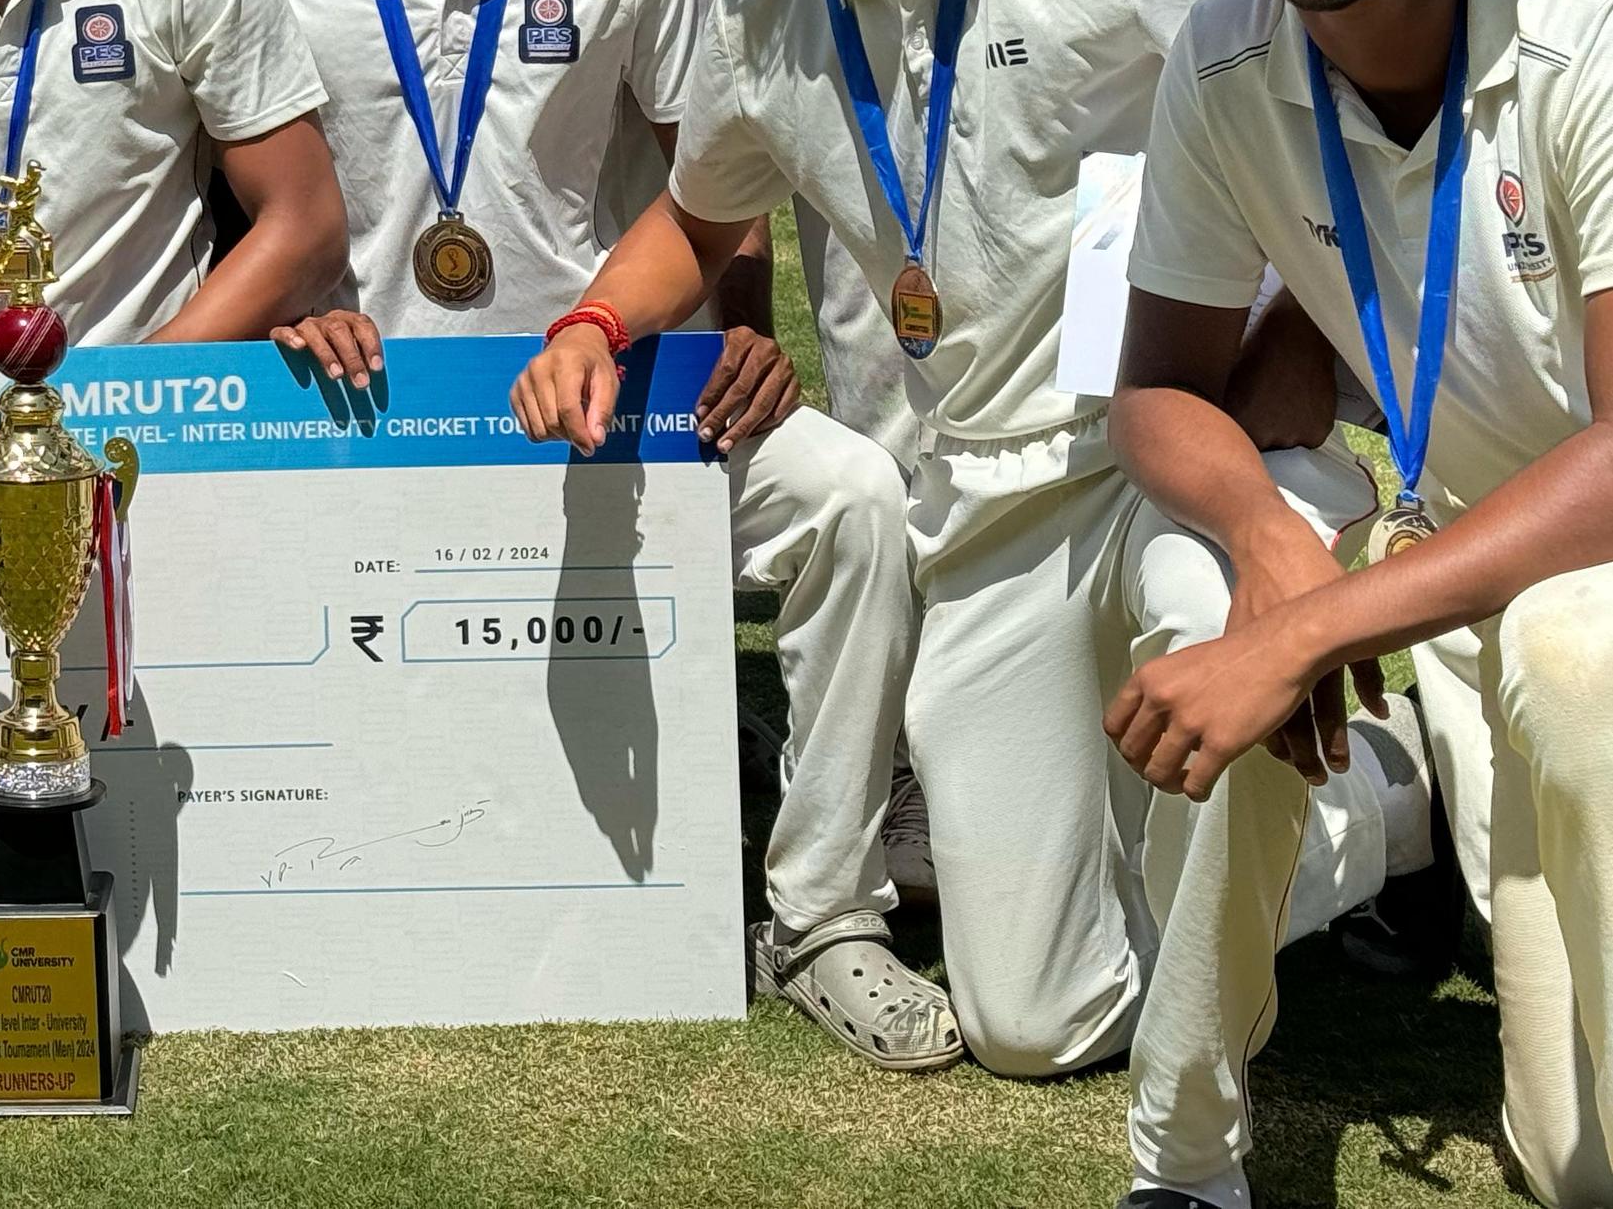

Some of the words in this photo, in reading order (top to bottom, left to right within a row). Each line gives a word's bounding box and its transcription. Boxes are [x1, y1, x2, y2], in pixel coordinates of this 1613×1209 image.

[526, 27, 573, 44] PES
[79, 44, 126, 62] PES
[1302, 215, 1341, 249] TYK
[1501, 232, 1546, 258] PS
[62, 375, 247, 417] MRUT20
[182, 422, 245, 443] INTER
[251, 418, 382, 441] UNIVERSITY
[386, 416, 480, 437] CRICKET
[434, 548, 454, 562] 16
[472, 547, 492, 561] 02
[510, 547, 550, 560] 2024
[354, 560, 401, 573] DATE:
[455, 615, 644, 651] 15,000/-
[177, 790, 235, 804] PAYER'S
[240, 789, 329, 803] SIGNATURE:
[10, 947, 35, 957] CMR
[11, 957, 75, 968] UNIVERSITY
[11, 985, 52, 1004] CMRUT20
[1, 1013, 20, 1032] level
[46, 1012, 87, 1035] University
[3, 1040, 51, 1059] Tournament
[52, 1042, 75, 1062] (Men)
[76, 1041, 95, 1058] 2024
